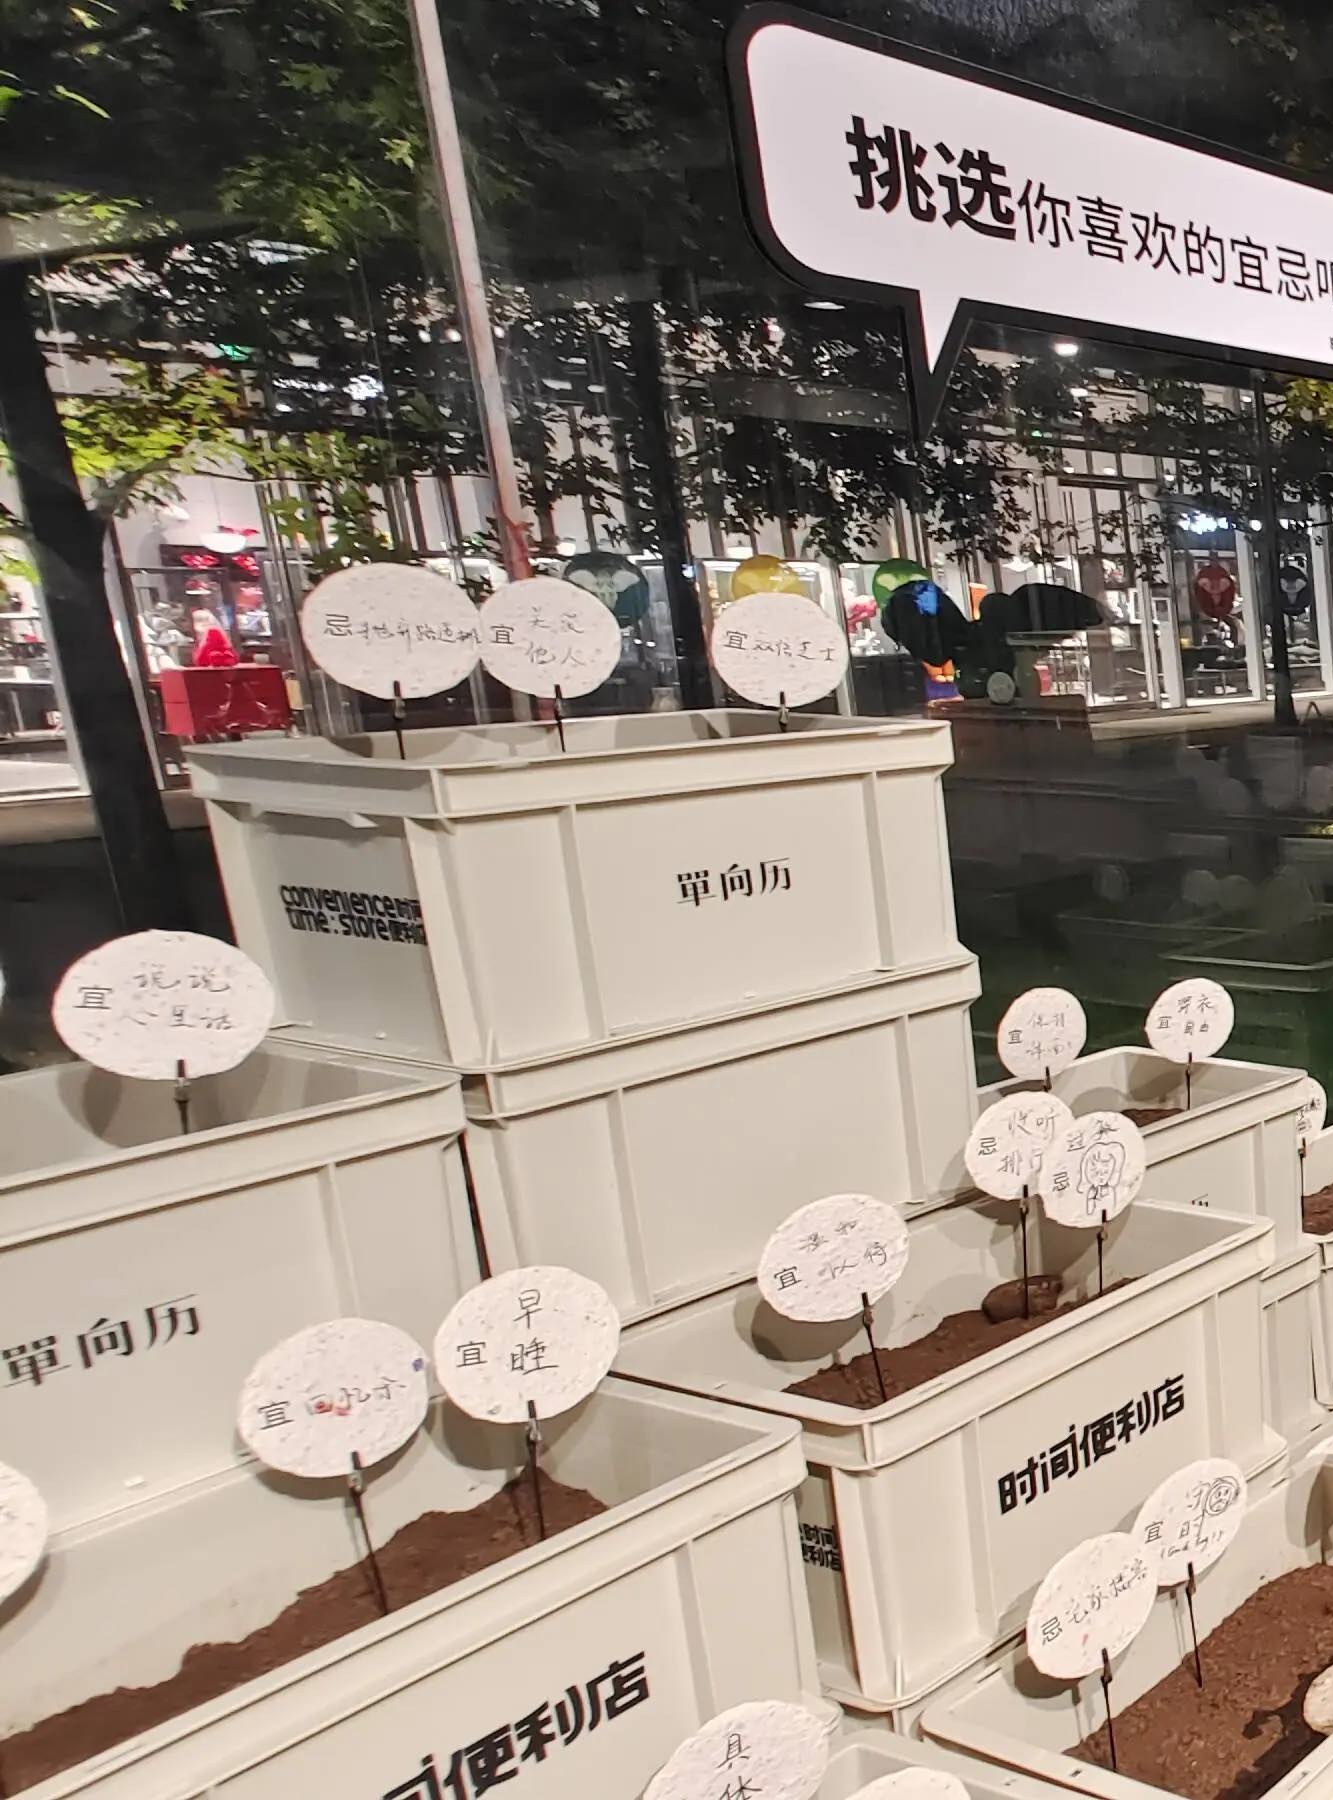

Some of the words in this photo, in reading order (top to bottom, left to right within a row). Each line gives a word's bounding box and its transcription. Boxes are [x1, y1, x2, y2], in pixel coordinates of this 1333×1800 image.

[280, 884, 396, 919] convenience
[676, 857, 793, 910] 單向历
[2, 1292, 201, 1389] 單向历
[997, 1373, 1186, 1517] 时间便利店
